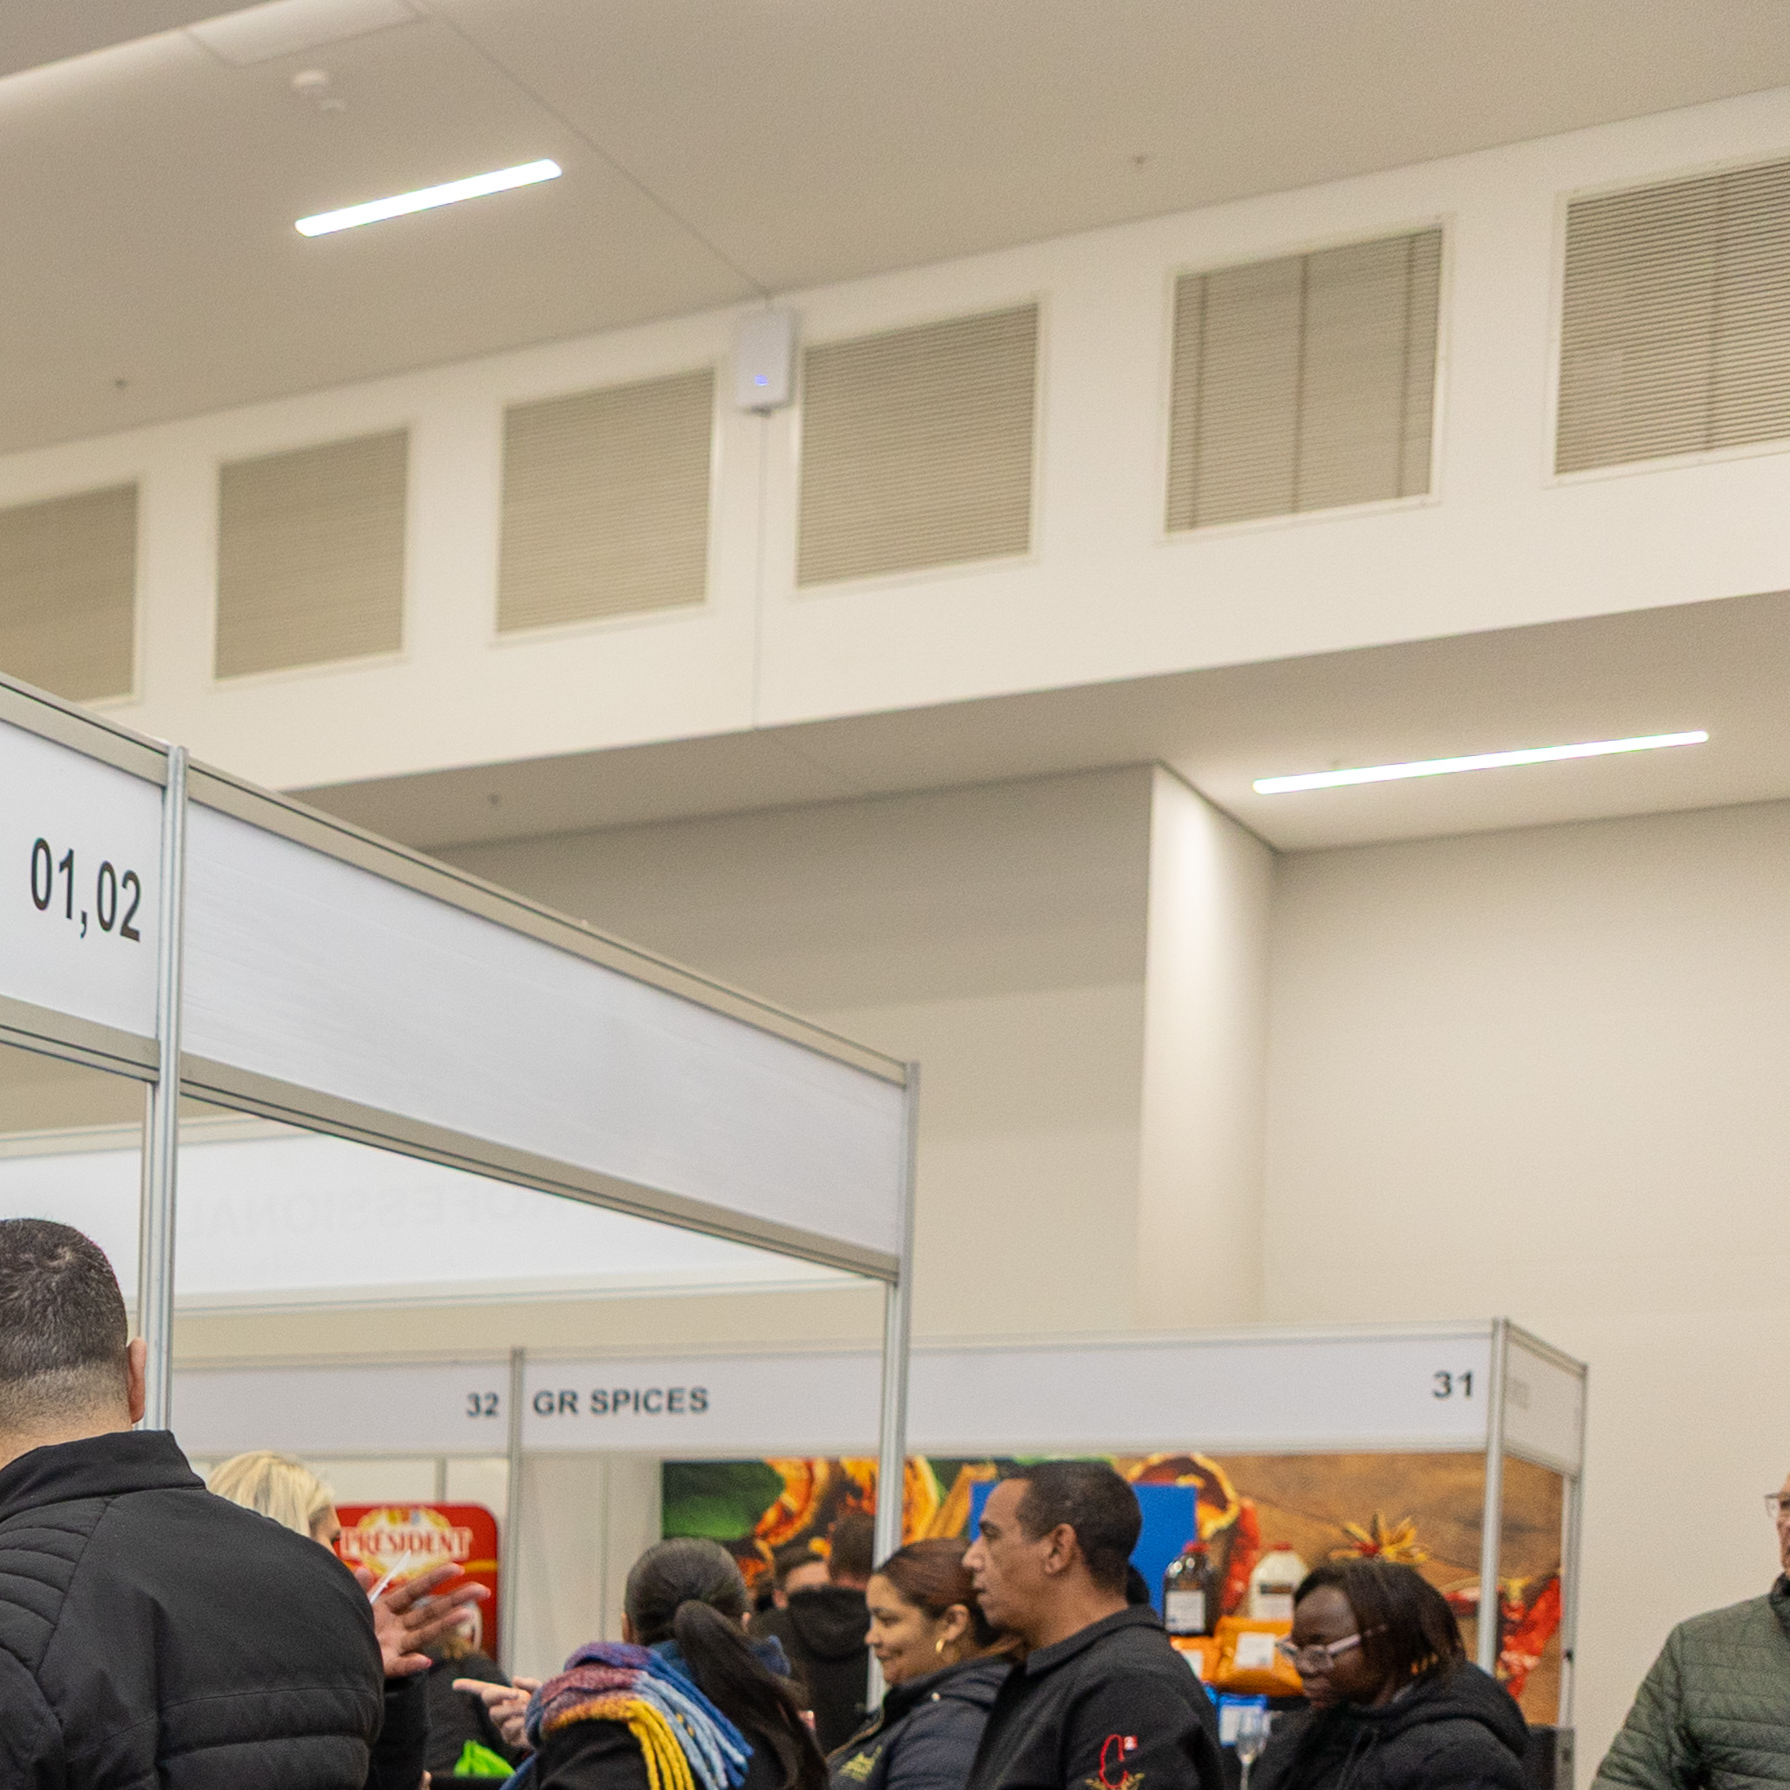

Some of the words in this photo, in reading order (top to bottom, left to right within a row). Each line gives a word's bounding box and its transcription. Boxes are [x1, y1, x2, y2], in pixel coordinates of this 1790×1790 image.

[30, 837, 142, 942] 01,02
[1431, 1370, 1474, 1399] 31
[467, 1392, 500, 1419] 32
[534, 1389, 580, 1416] GR
[590, 1386, 710, 1416] SPICES
